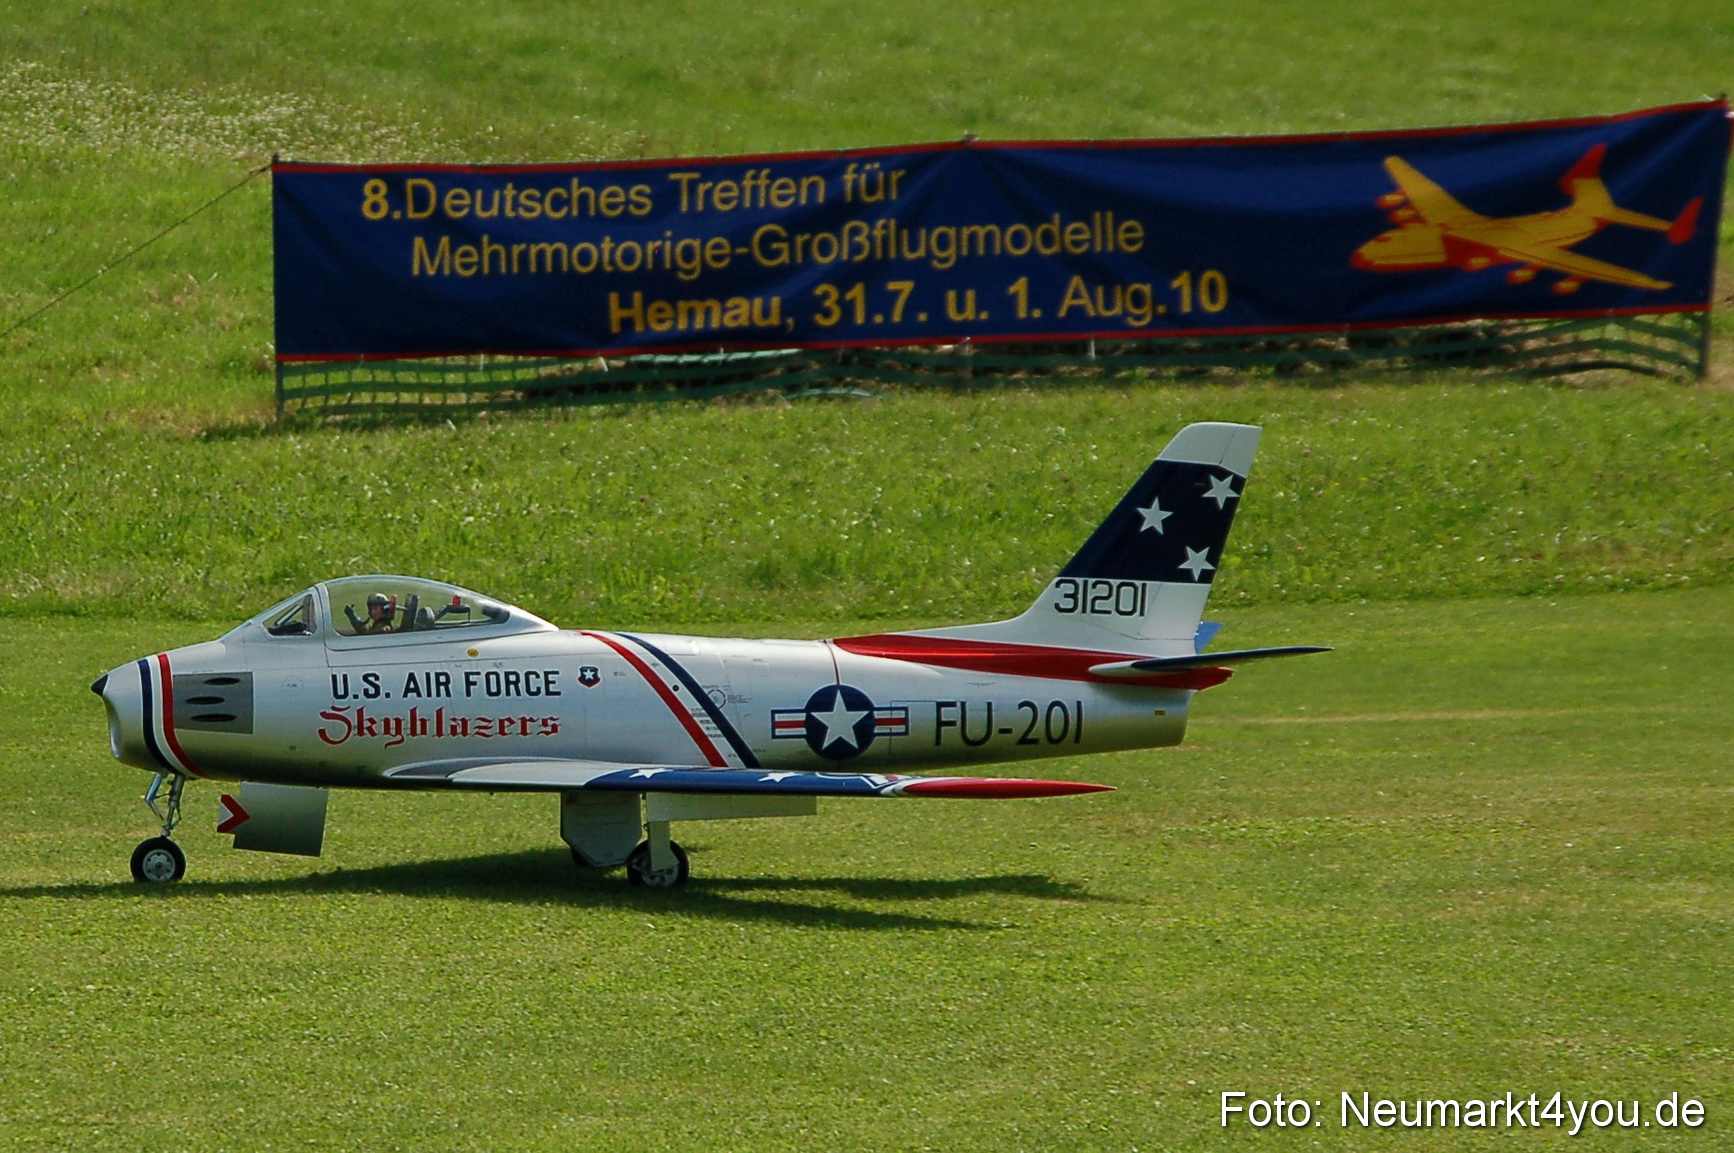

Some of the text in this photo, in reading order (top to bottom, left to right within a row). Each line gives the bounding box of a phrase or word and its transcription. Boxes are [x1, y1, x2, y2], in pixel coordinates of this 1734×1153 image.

[669, 168, 825, 212] Treffen
[843, 163, 905, 203] für
[412, 211, 1145, 280] Mehrmotorige-Großflugmodelle
[609, 291, 795, 334] Hemau,
[813, 281, 928, 326] 31.7.
[946, 289, 989, 321] u.
[1008, 277, 1042, 318] 1.
[1054, 578, 1147, 616] 31201
[331, 670, 562, 699] U.S. AIR FORCE
[317, 704, 562, 748] Skyblazers
[935, 700, 1084, 748] FU-201
